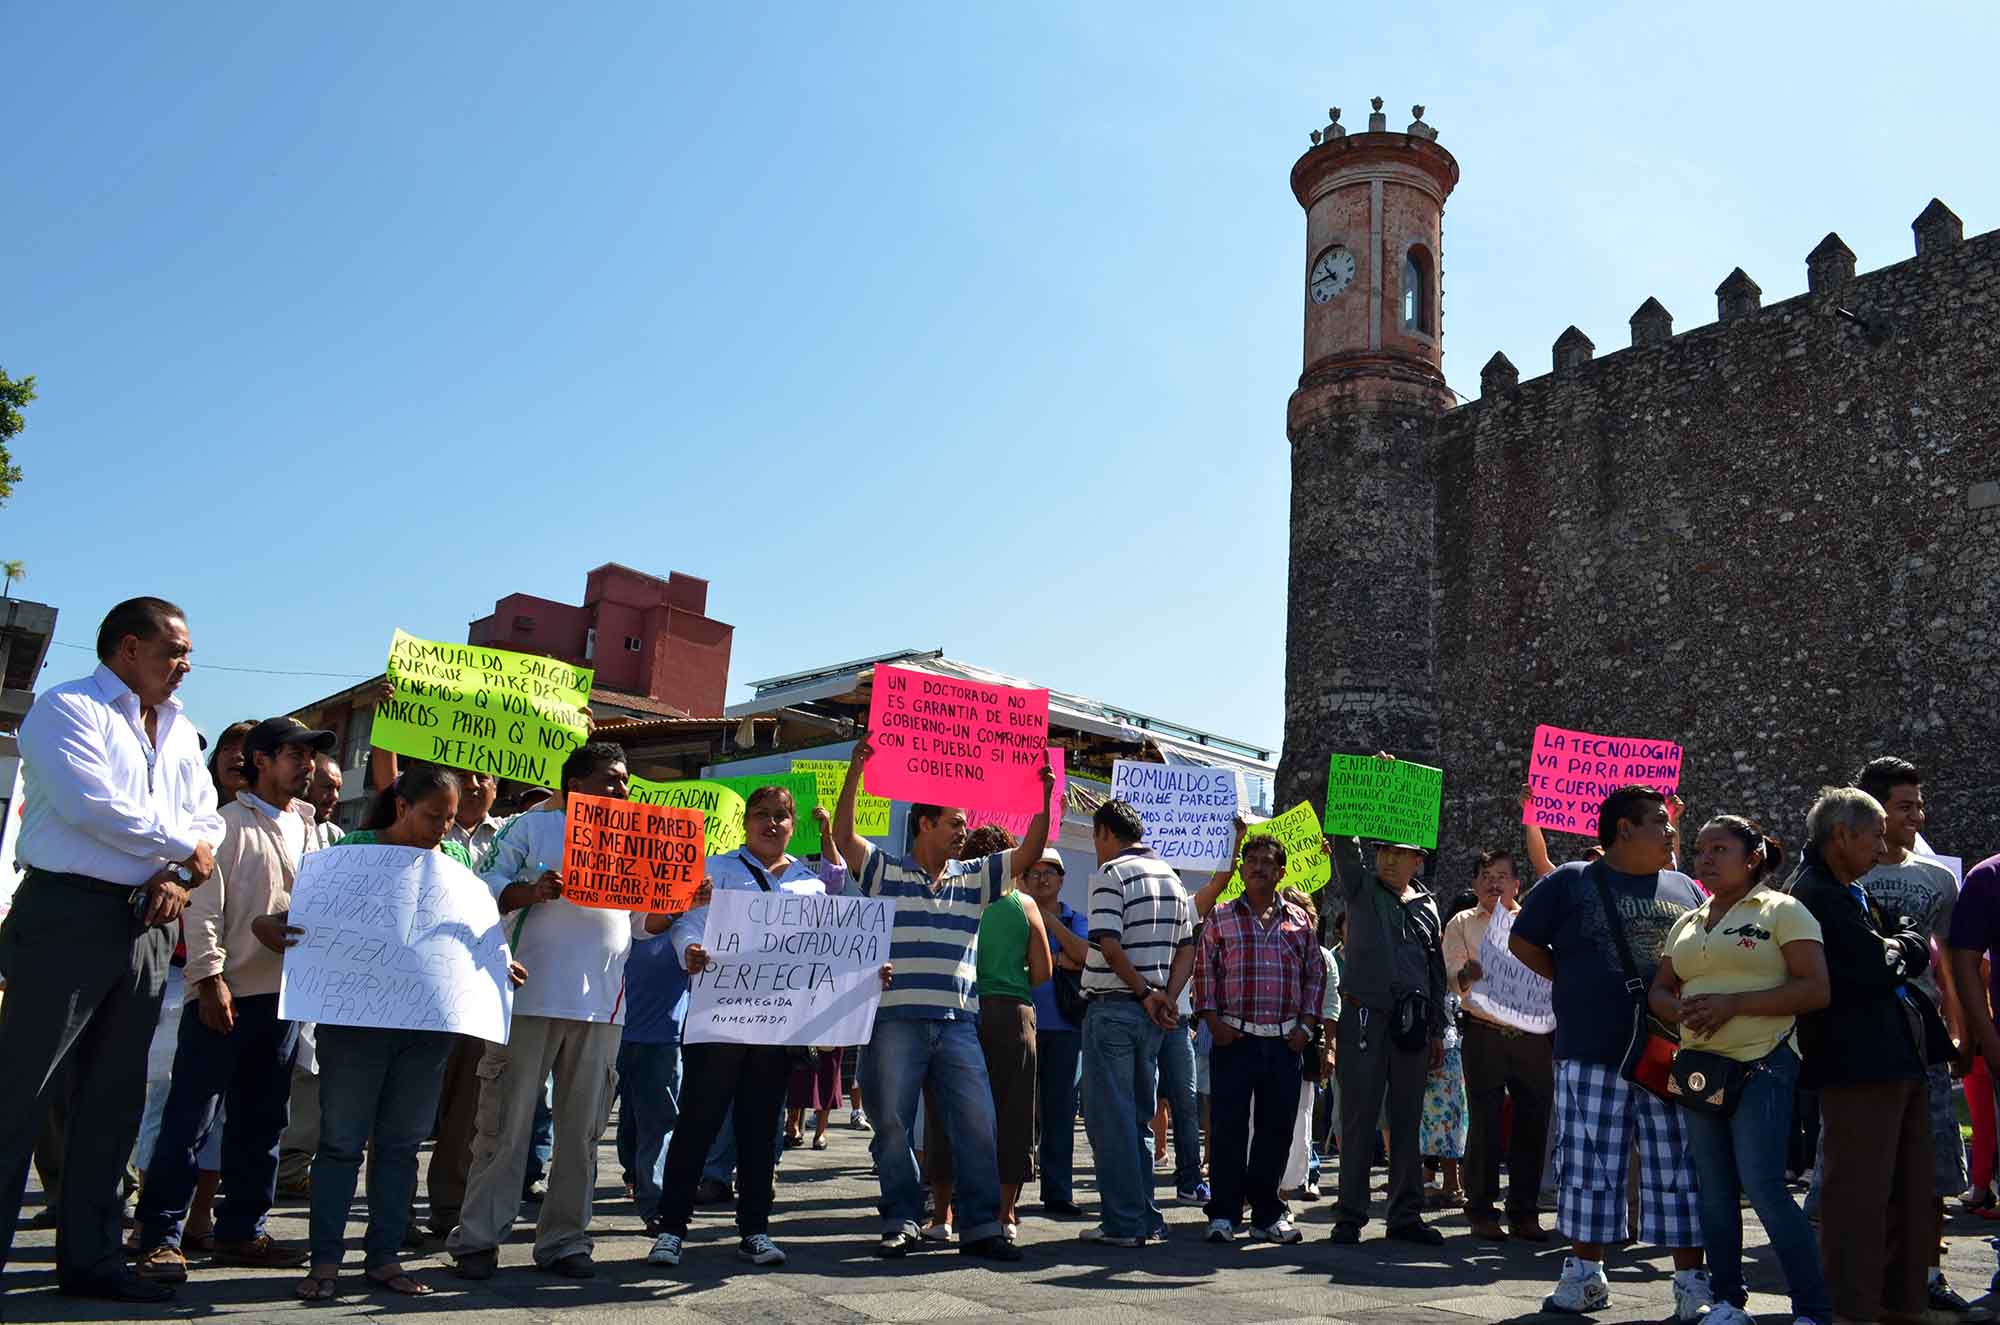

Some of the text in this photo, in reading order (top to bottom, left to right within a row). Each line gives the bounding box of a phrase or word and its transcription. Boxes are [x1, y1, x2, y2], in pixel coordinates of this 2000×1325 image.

[388, 654, 562, 702] ENRIQUE PAREDES
[519, 659, 589, 693] SALGADO
[888, 676, 1026, 709] UN DOCTORADO NO
[887, 694, 1043, 728] ES GARANTIA DE BUEN
[378, 700, 438, 727] NARCOS
[452, 710, 496, 739] PARA
[538, 727, 578, 754] NOS
[976, 727, 1047, 751] COMPROMISO
[878, 732, 1040, 766] CON EL PUEBLO SI HAY
[1543, 733, 1680, 760] LA TECNOLOGIA
[1116, 765, 1209, 792] ROMUALDO
[1337, 756, 1398, 775] ENRIQUE
[1537, 753, 1558, 768] VA
[1568, 758, 1618, 779] PARA
[1331, 772, 1391, 788] ROMUALDO
[1530, 773, 1548, 789] TE
[1115, 790, 1238, 806] ENRIQUE PAREDES
[1567, 801, 1576, 811] Y
[1581, 802, 1602, 815] DO
[574, 802, 641, 832] ENRIQUE
[1266, 808, 1312, 834] SALGADO
[1536, 811, 1576, 827] PARA
[1160, 826, 1187, 837] PARA
[1206, 826, 1230, 837] NOS
[599, 831, 697, 864] MENTIROSO
[568, 869, 579, 886] A
[567, 889, 599, 903] ESTAS
[605, 894, 644, 905] OYENDO
[747, 896, 886, 933] CUERNAVACA
[716, 932, 878, 964] LA DICTADURA
[698, 962, 835, 992] PERFECTA
[717, 996, 793, 1007] CORREGIDA
[711, 1014, 788, 1025] AUMENTADA
